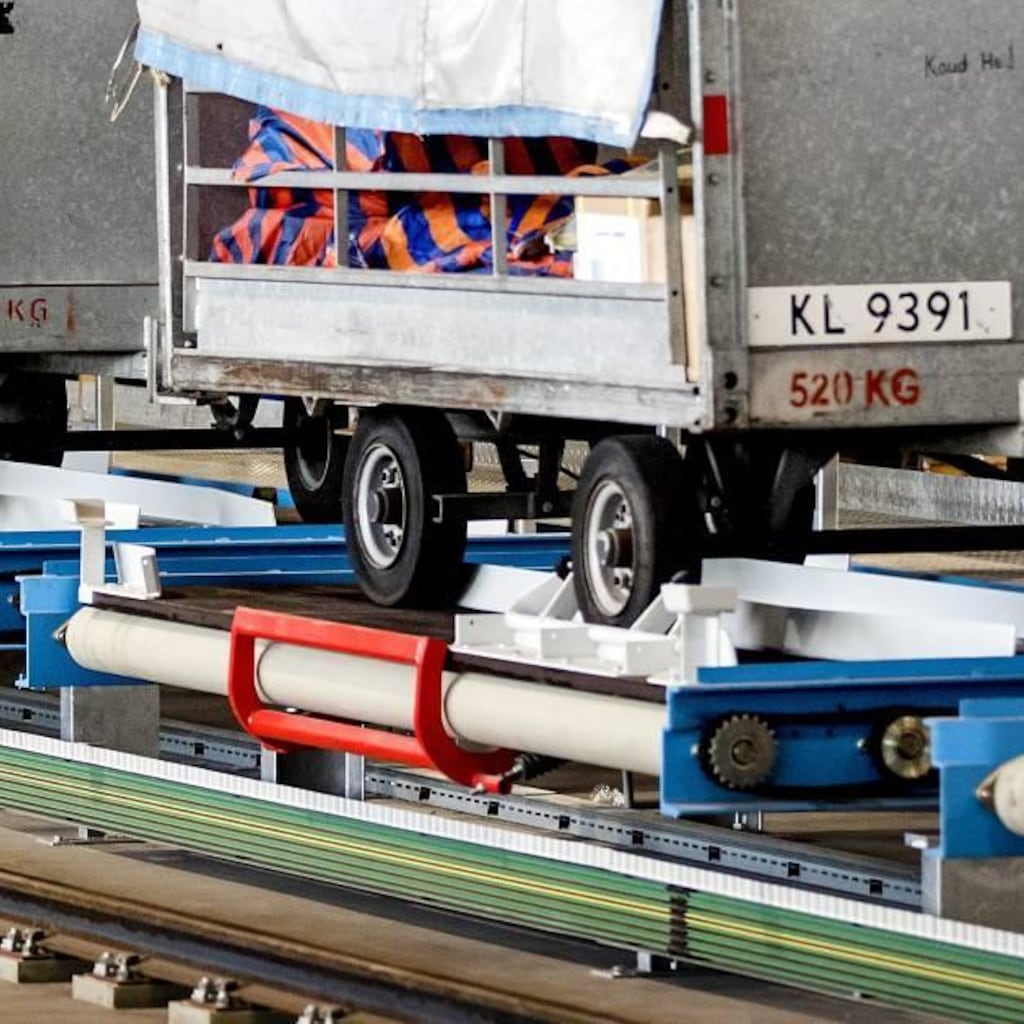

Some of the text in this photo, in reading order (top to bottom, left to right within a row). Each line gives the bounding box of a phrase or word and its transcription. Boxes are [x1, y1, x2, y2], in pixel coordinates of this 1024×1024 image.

[8, 298, 48, 324] KG
[791, 291, 970, 335] KL 9391
[790, 367, 921, 408] 520 KG
